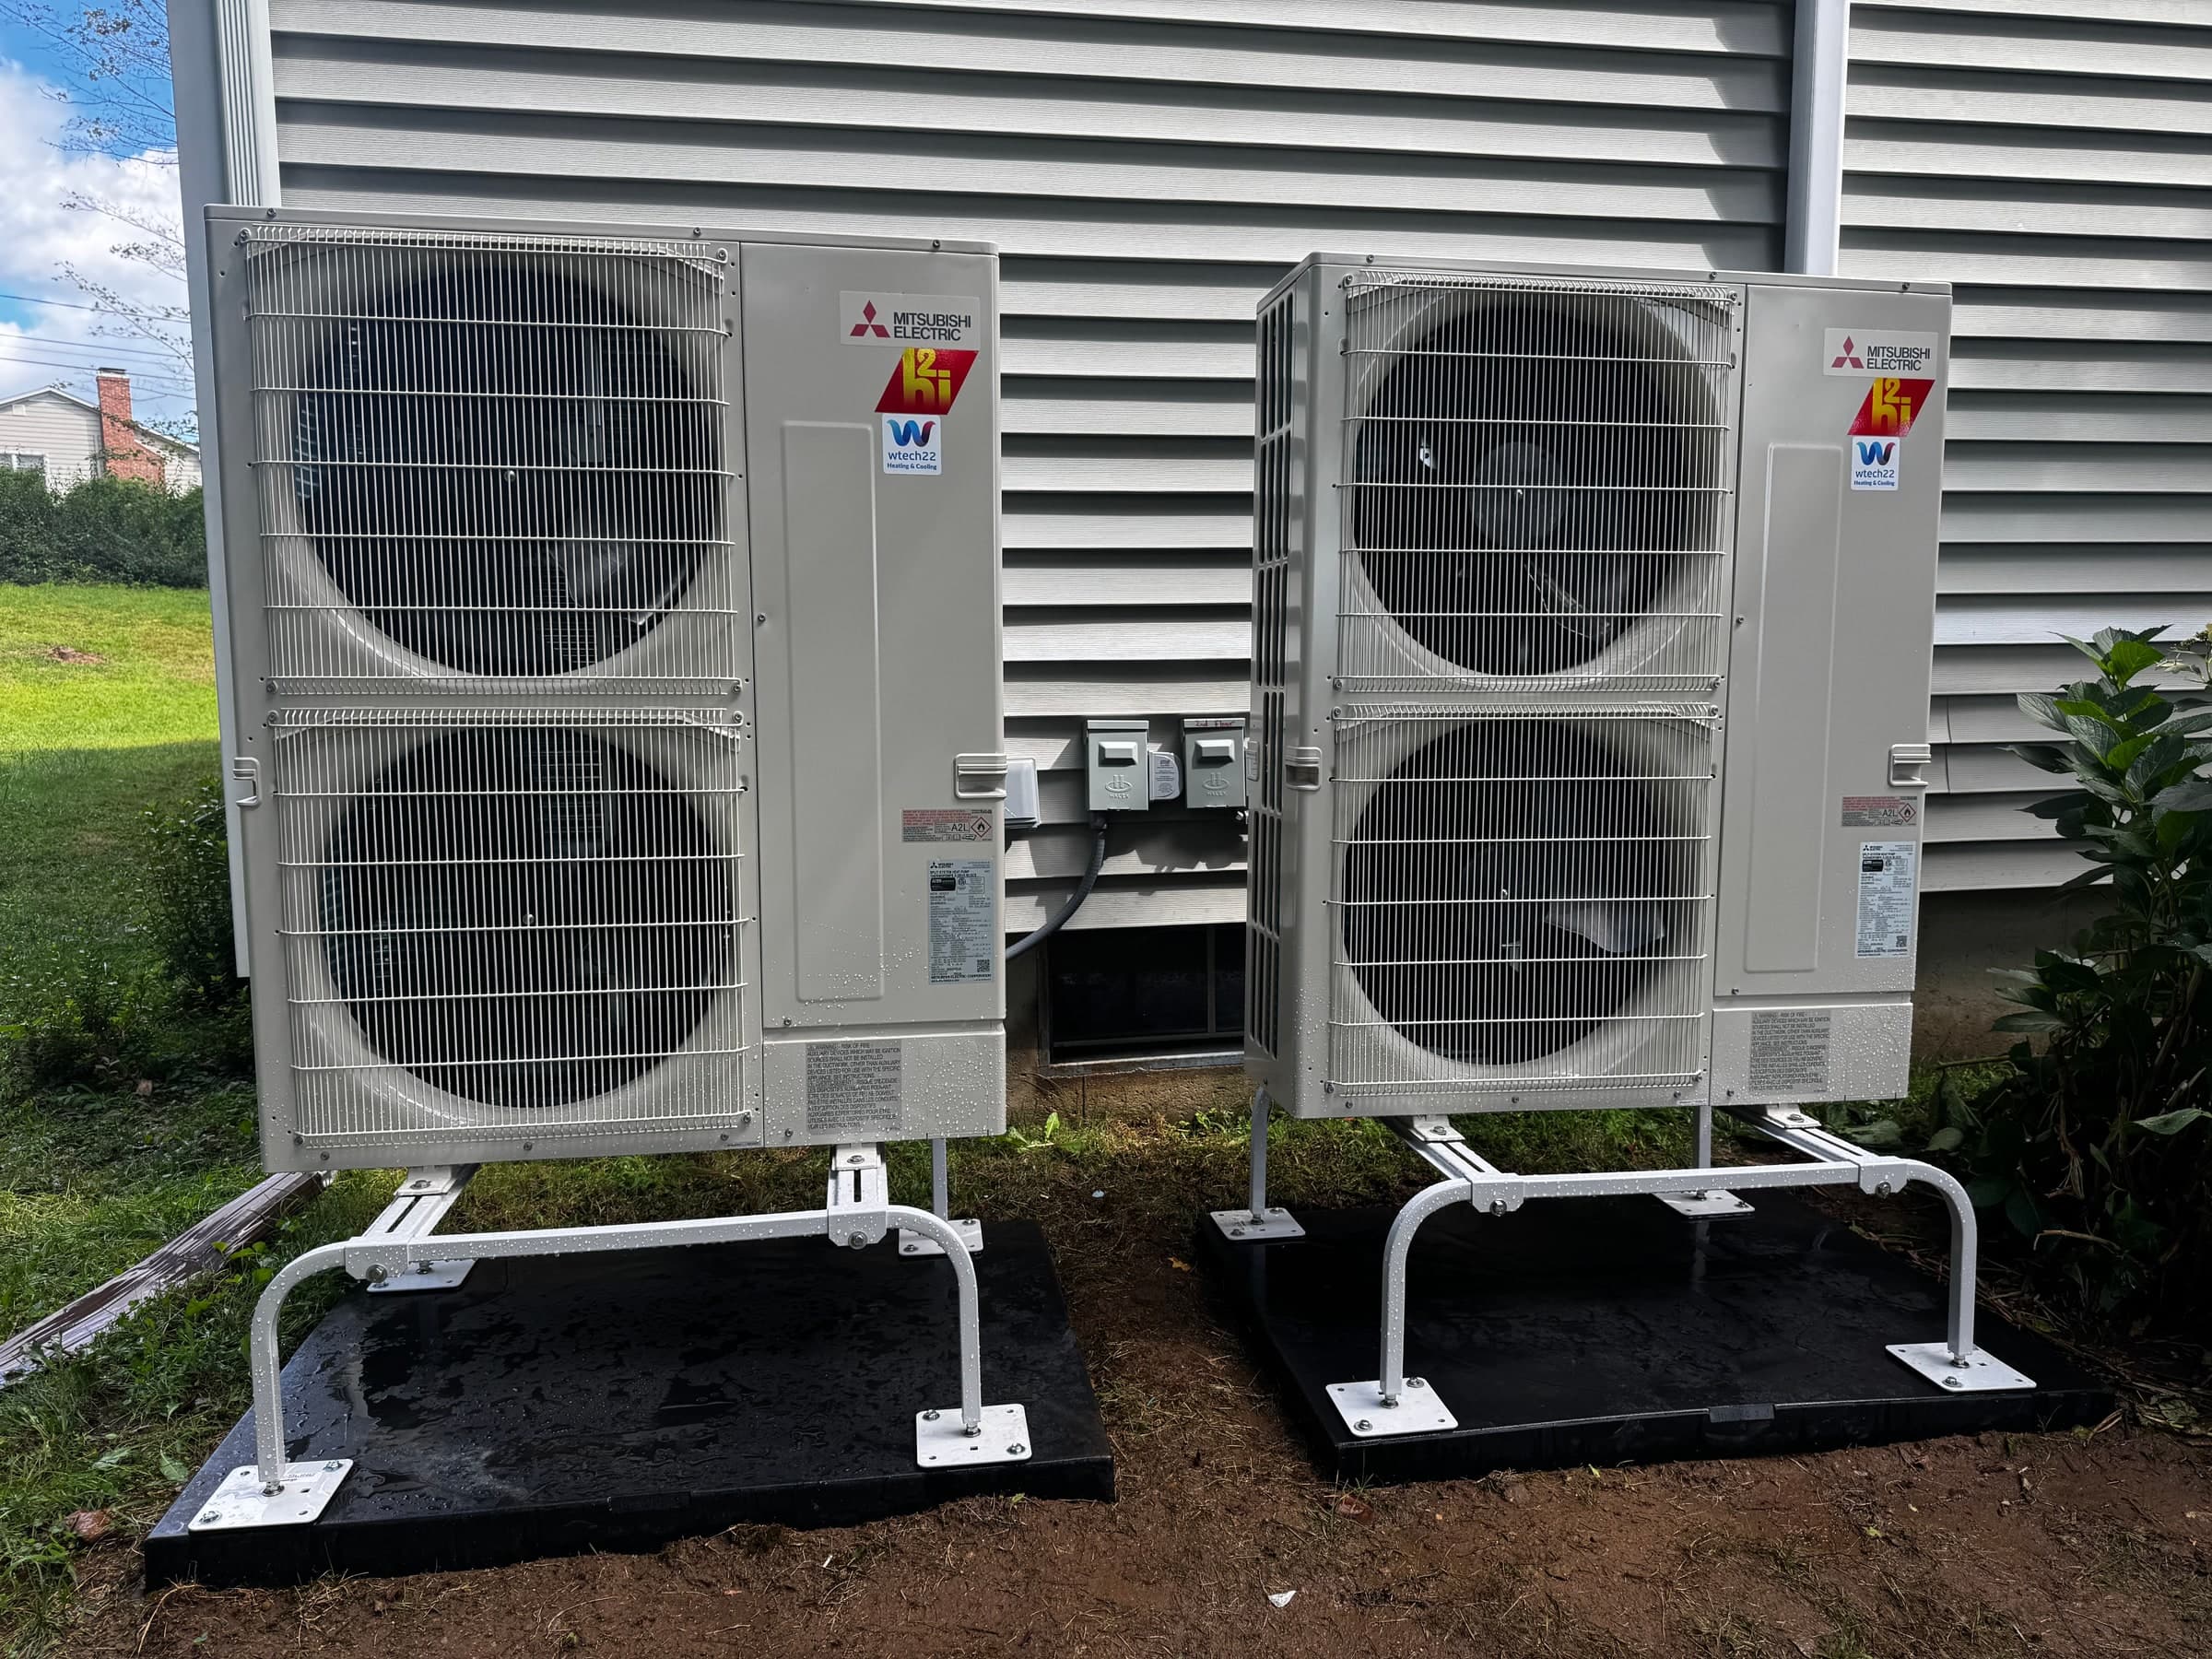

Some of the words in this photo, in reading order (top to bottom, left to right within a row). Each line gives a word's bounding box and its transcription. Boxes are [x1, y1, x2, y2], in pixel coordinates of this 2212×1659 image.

[893, 312, 971, 328] MITSUBISHI
[894, 326, 961, 341] ELECTRIC
[1867, 346, 1931, 359] MITSUBISHI
[1867, 358, 1922, 371] ELECTRIC
[888, 450, 936, 461] wtech22
[1855, 469, 1895, 478] wtech22
